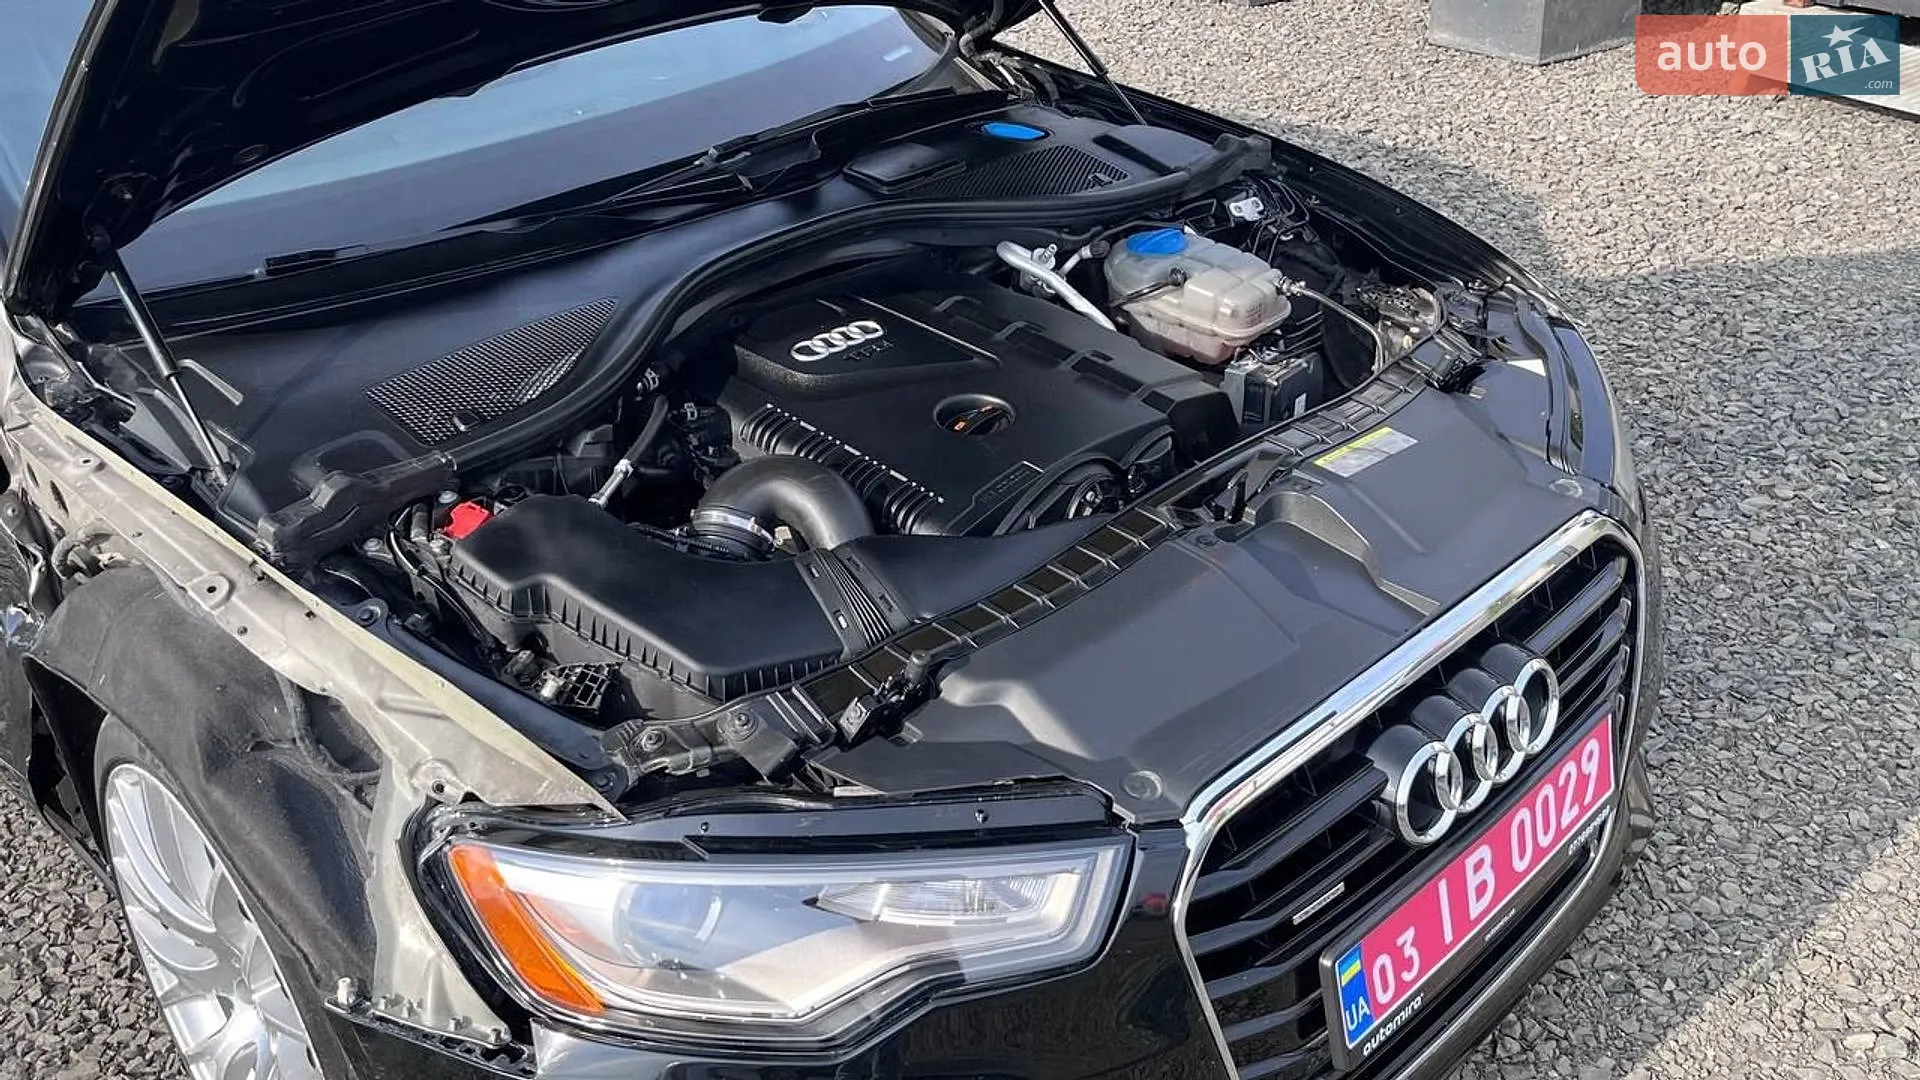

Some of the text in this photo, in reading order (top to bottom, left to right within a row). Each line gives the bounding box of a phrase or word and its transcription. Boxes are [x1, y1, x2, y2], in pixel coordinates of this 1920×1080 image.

[1372, 926, 1420, 1006] 03
[1510, 738, 1602, 874] 0029
[1346, 996, 1370, 1031] UA
